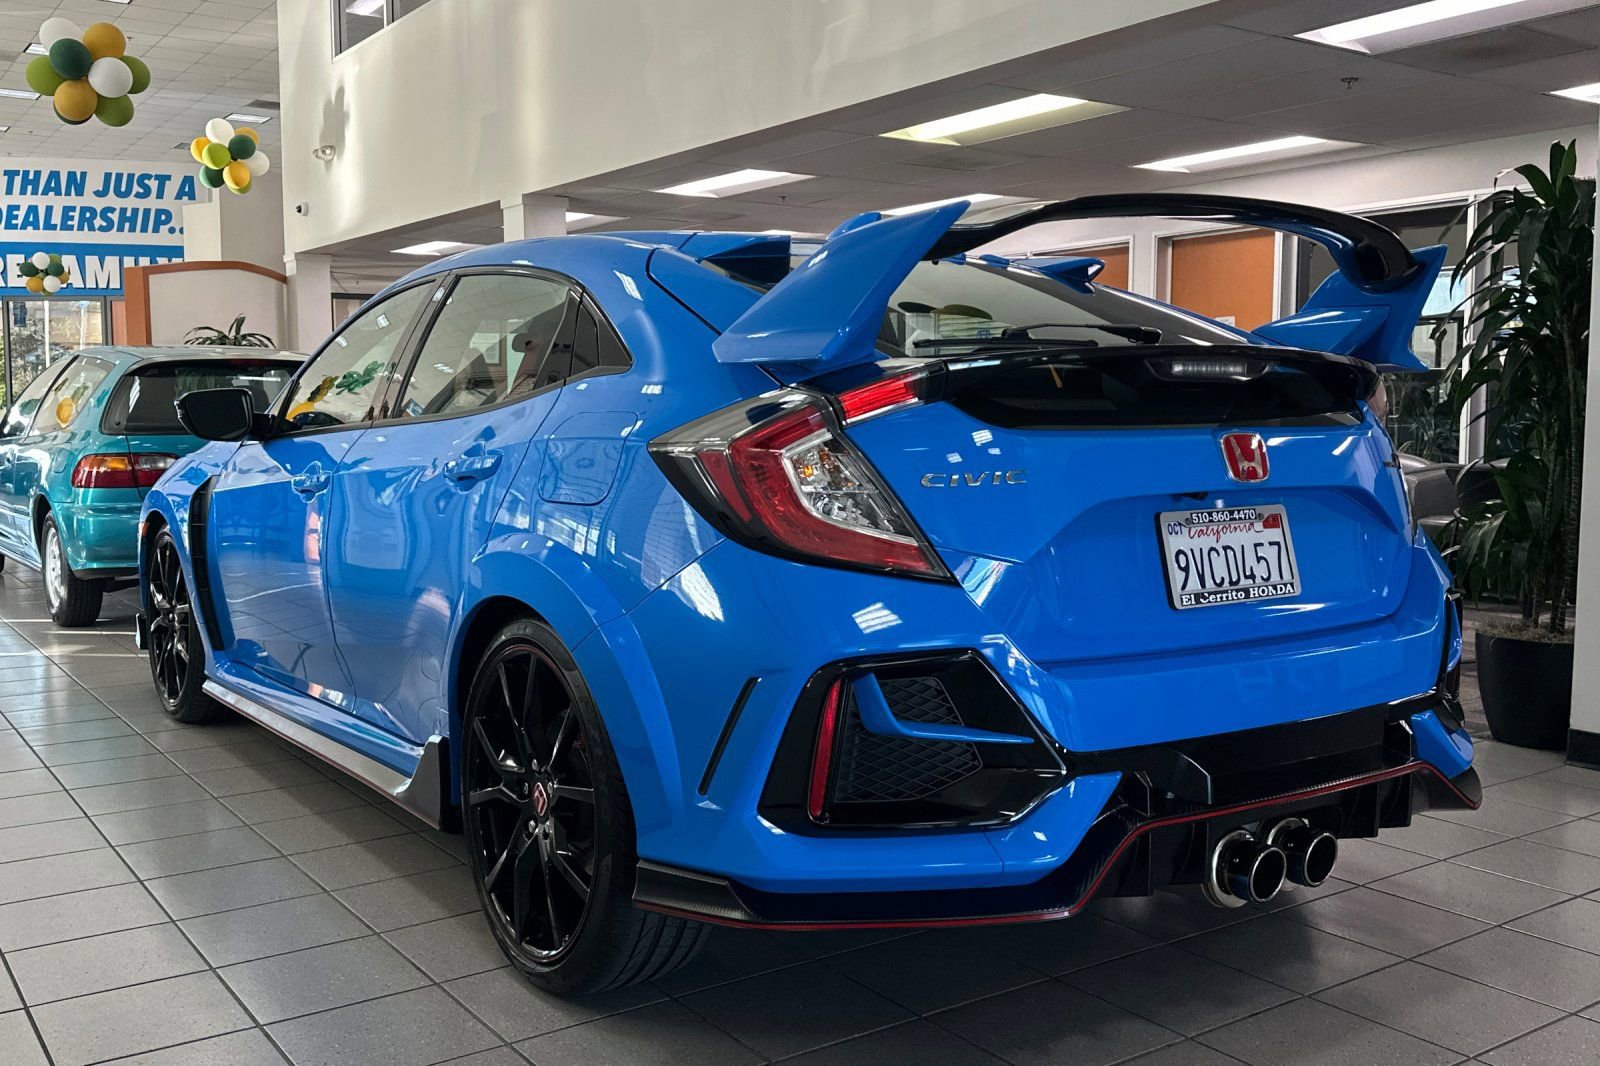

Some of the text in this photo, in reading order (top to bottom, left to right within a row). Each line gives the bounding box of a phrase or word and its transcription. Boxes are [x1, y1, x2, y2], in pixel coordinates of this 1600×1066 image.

[4, 170, 196, 200] THAN JUST A
[0, 205, 184, 234] EALERSHIP..
[921, 470, 1028, 487] CIVIC
[1192, 509, 1256, 523] 510-860-4470
[1167, 523, 1183, 536] OCT
[1188, 523, 1264, 543] California
[1174, 541, 1283, 591] 9VCD457
[1181, 584, 1295, 606] El Cerrito HONDA
